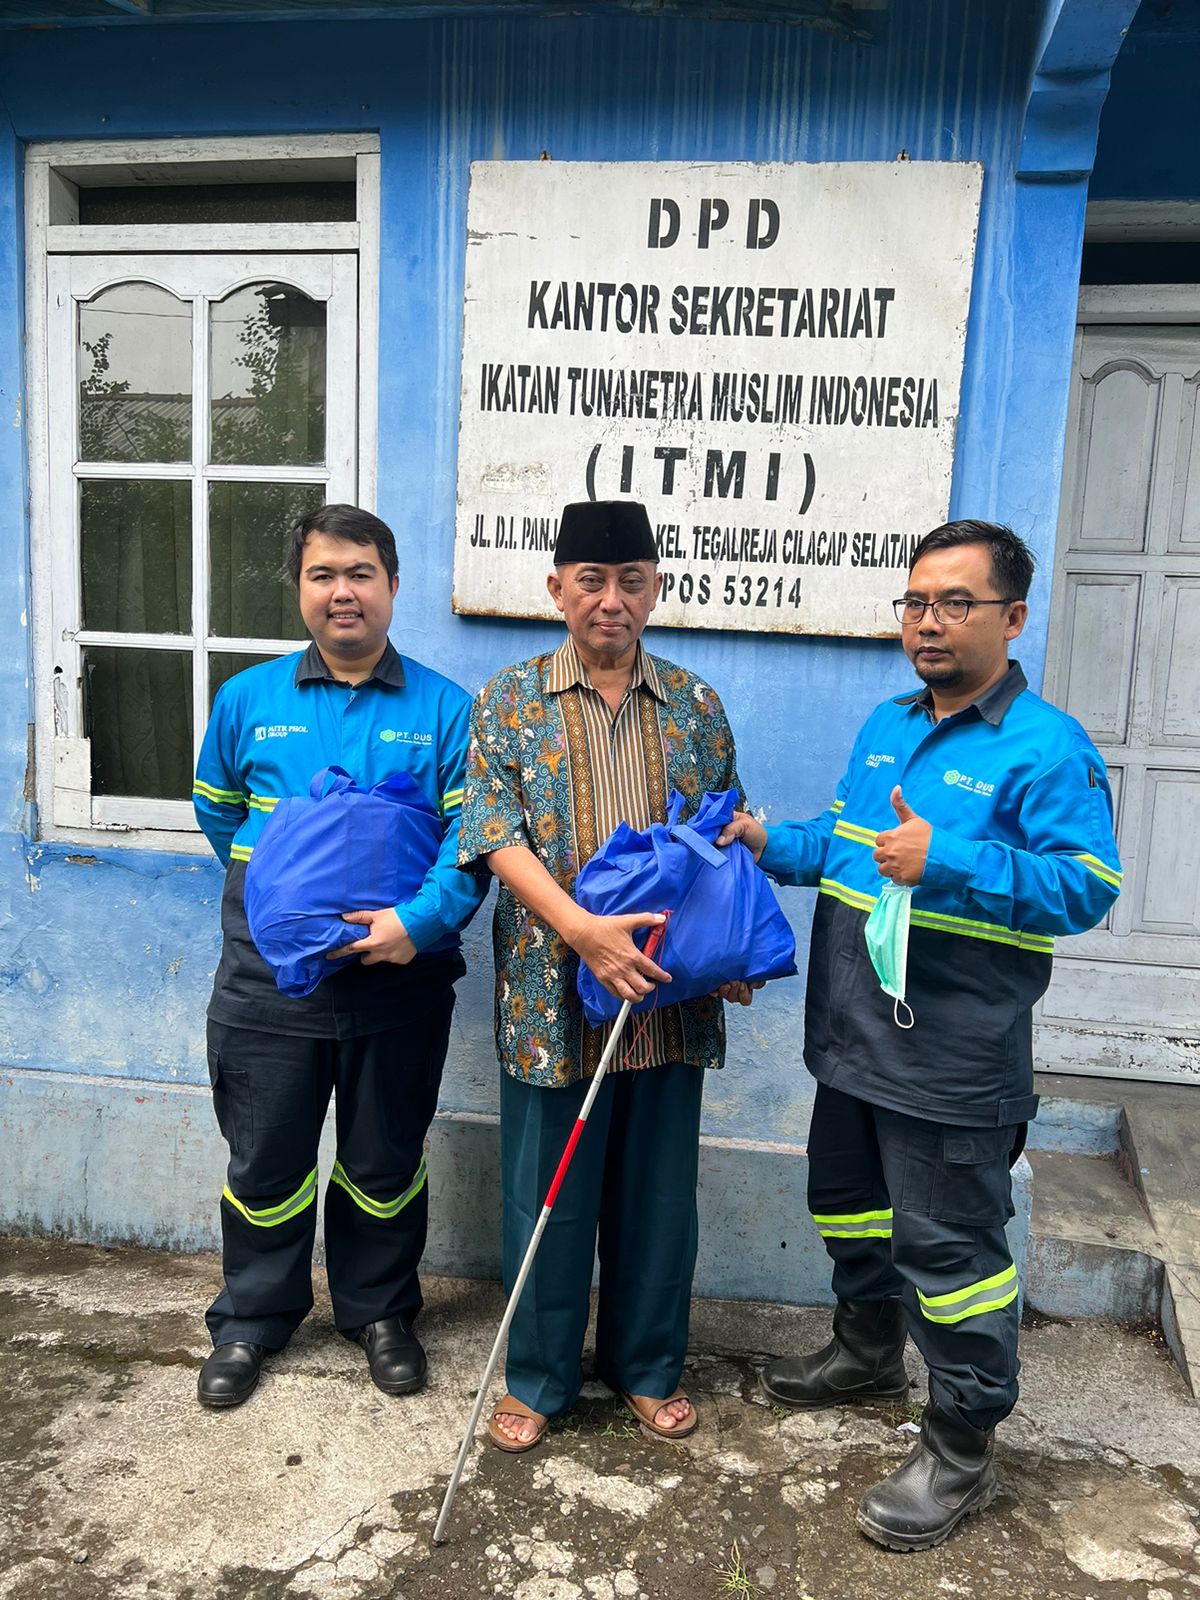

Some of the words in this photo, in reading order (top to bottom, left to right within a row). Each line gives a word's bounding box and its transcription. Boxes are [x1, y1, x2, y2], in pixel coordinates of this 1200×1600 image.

[527, 280, 660, 334] KANTOR
[669, 284, 896, 339] SEKRETARIAT
[480, 363, 560, 414] IKATAN
[567, 367, 702, 420] TUNANETRA
[710, 372, 804, 424] MUSLIM
[808, 375, 938, 428] INDONESIA
[470, 514, 490, 548] JL.
[495, 515, 517, 550] D.I.
[521, 517, 558, 552] PANJ
[656, 524, 686, 559] KEL.
[692, 525, 777, 564] TEGALREJA
[782, 529, 848, 566] CILACAP
[851, 532, 921, 569] SELATAN
[661, 572, 711, 605] POS
[723, 575, 802, 609] 53214
[413, 733, 432, 742] DUS
[976, 781, 995, 793] DUS
